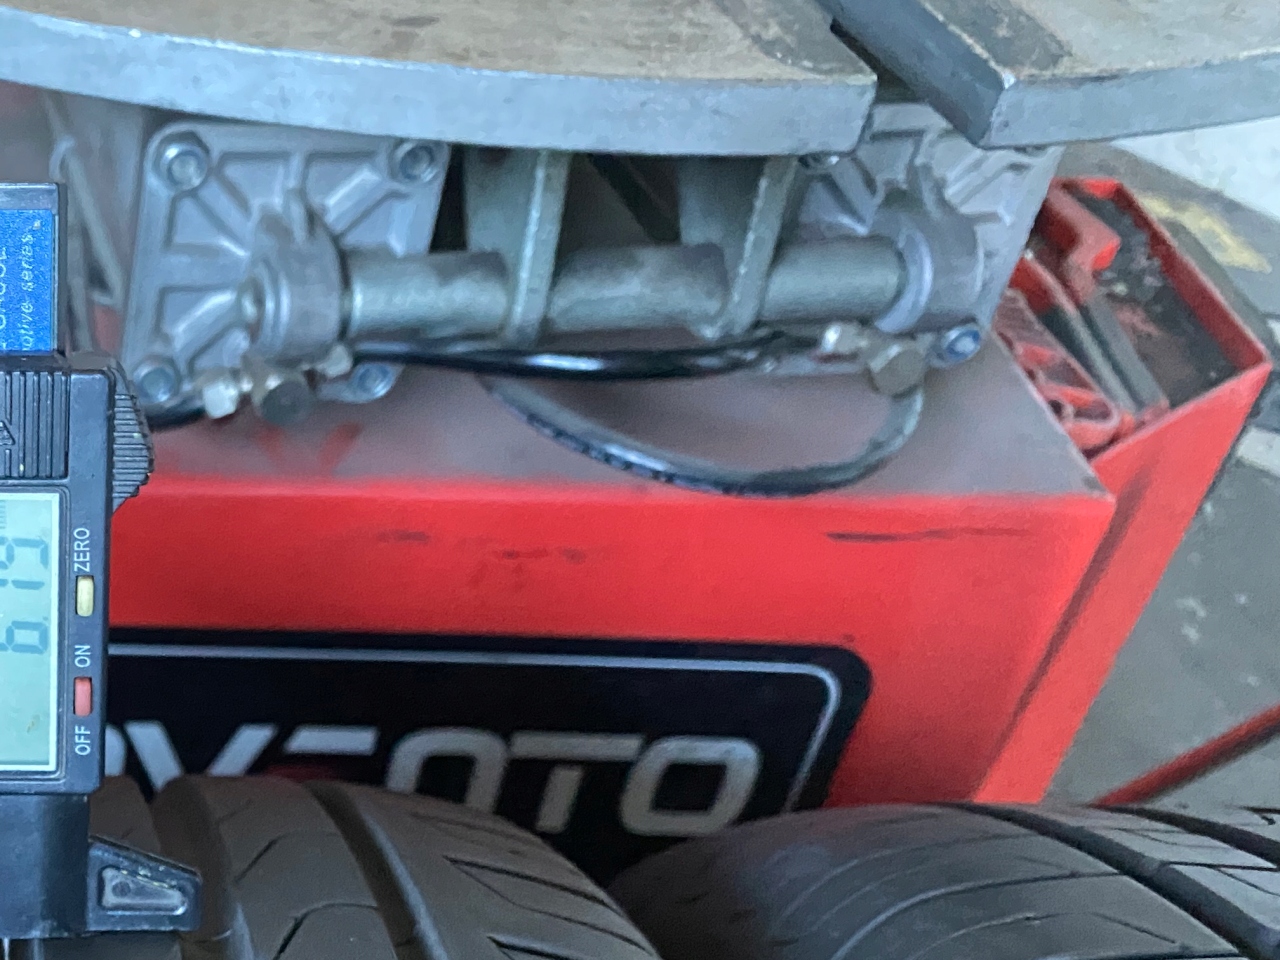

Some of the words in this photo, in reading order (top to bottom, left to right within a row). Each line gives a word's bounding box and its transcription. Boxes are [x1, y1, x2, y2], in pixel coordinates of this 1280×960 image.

[74, 527, 91, 572] ZERO
[74, 643, 91, 668] ON
[74, 725, 91, 756] OFF
